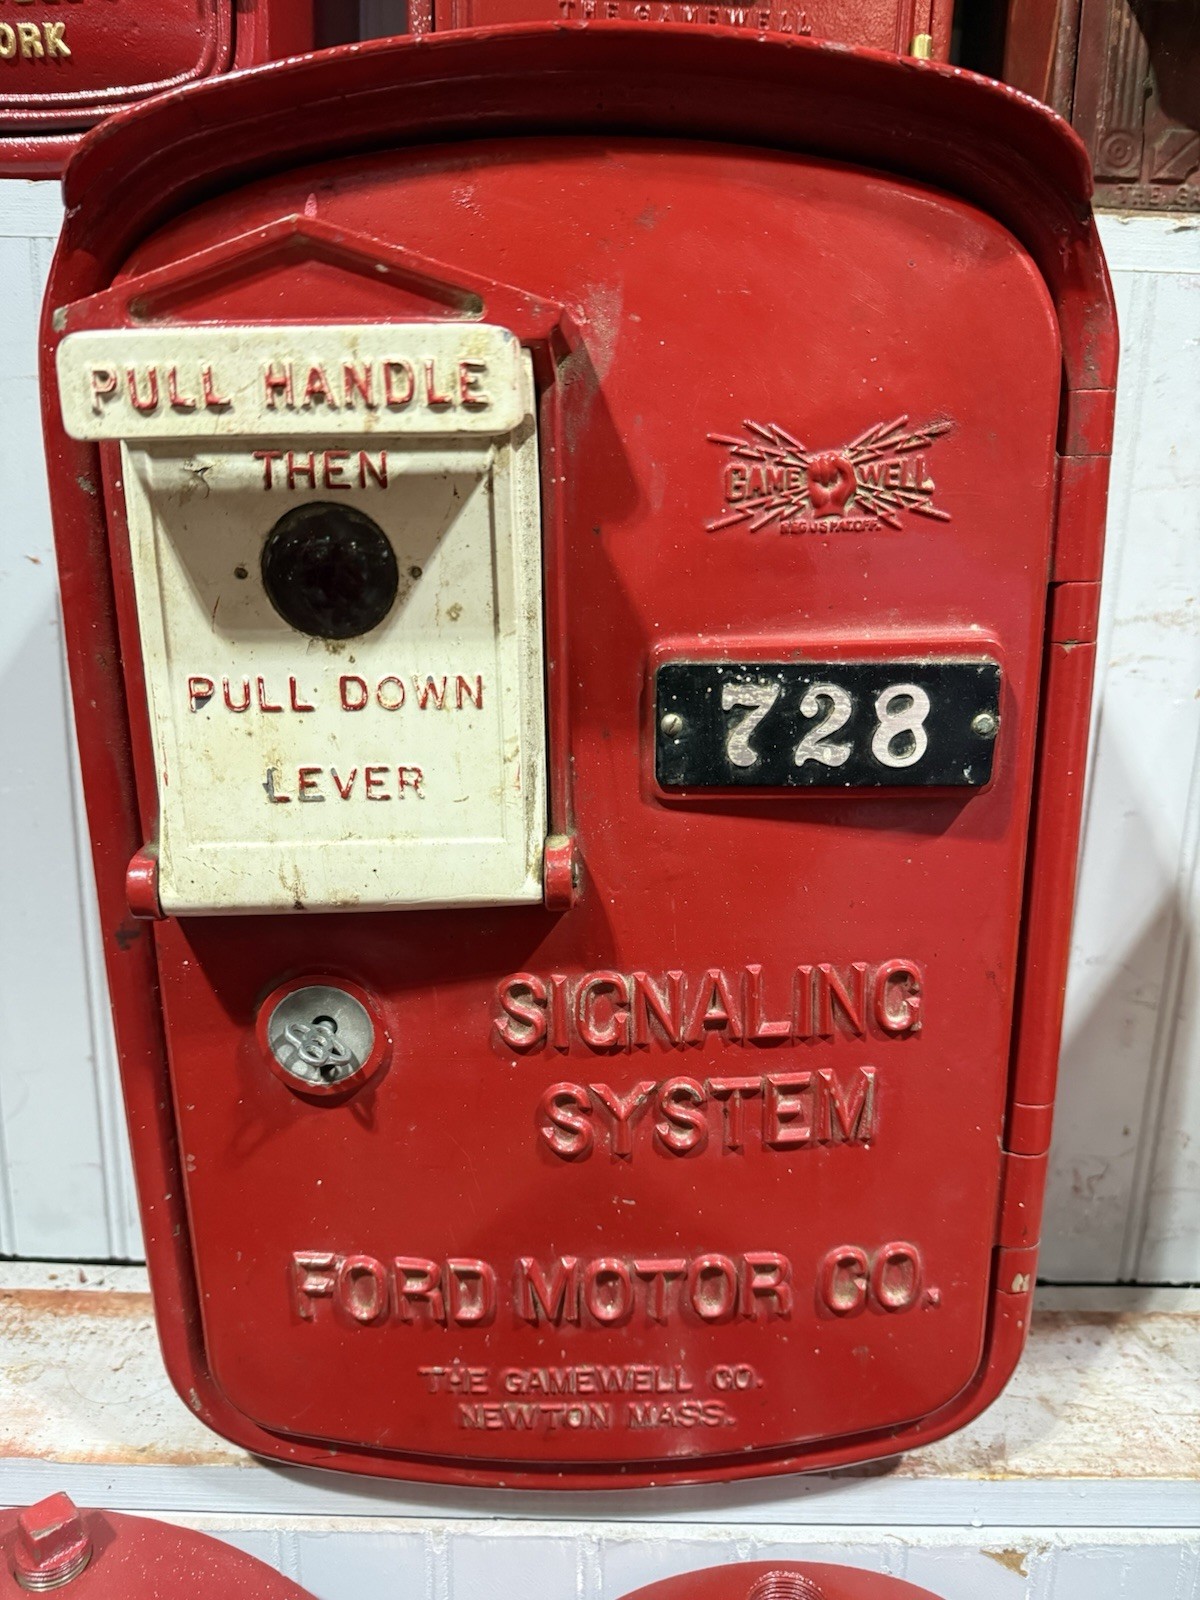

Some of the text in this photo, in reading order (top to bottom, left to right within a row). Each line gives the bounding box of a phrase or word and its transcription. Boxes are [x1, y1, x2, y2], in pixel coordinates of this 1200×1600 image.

[558, 0, 813, 36] THE GAMEWELL
[0, 21, 72, 59] ORK
[89, 355, 490, 415] PULL HANDLE
[253, 449, 389, 492] THEN
[724, 454, 936, 503] GAME WELL
[188, 674, 484, 712] PULL DOWN
[721, 682, 931, 768] 728
[263, 765, 426, 804] LEVER
[493, 957, 925, 1052] SIGNALING
[538, 1065, 878, 1161] SYSTEM
[290, 1240, 940, 1323] FORD MOTOR CO.
[418, 1363, 764, 1396] THE GAMEWELL CO.
[459, 1400, 738, 1431] NEWTON MASS.
